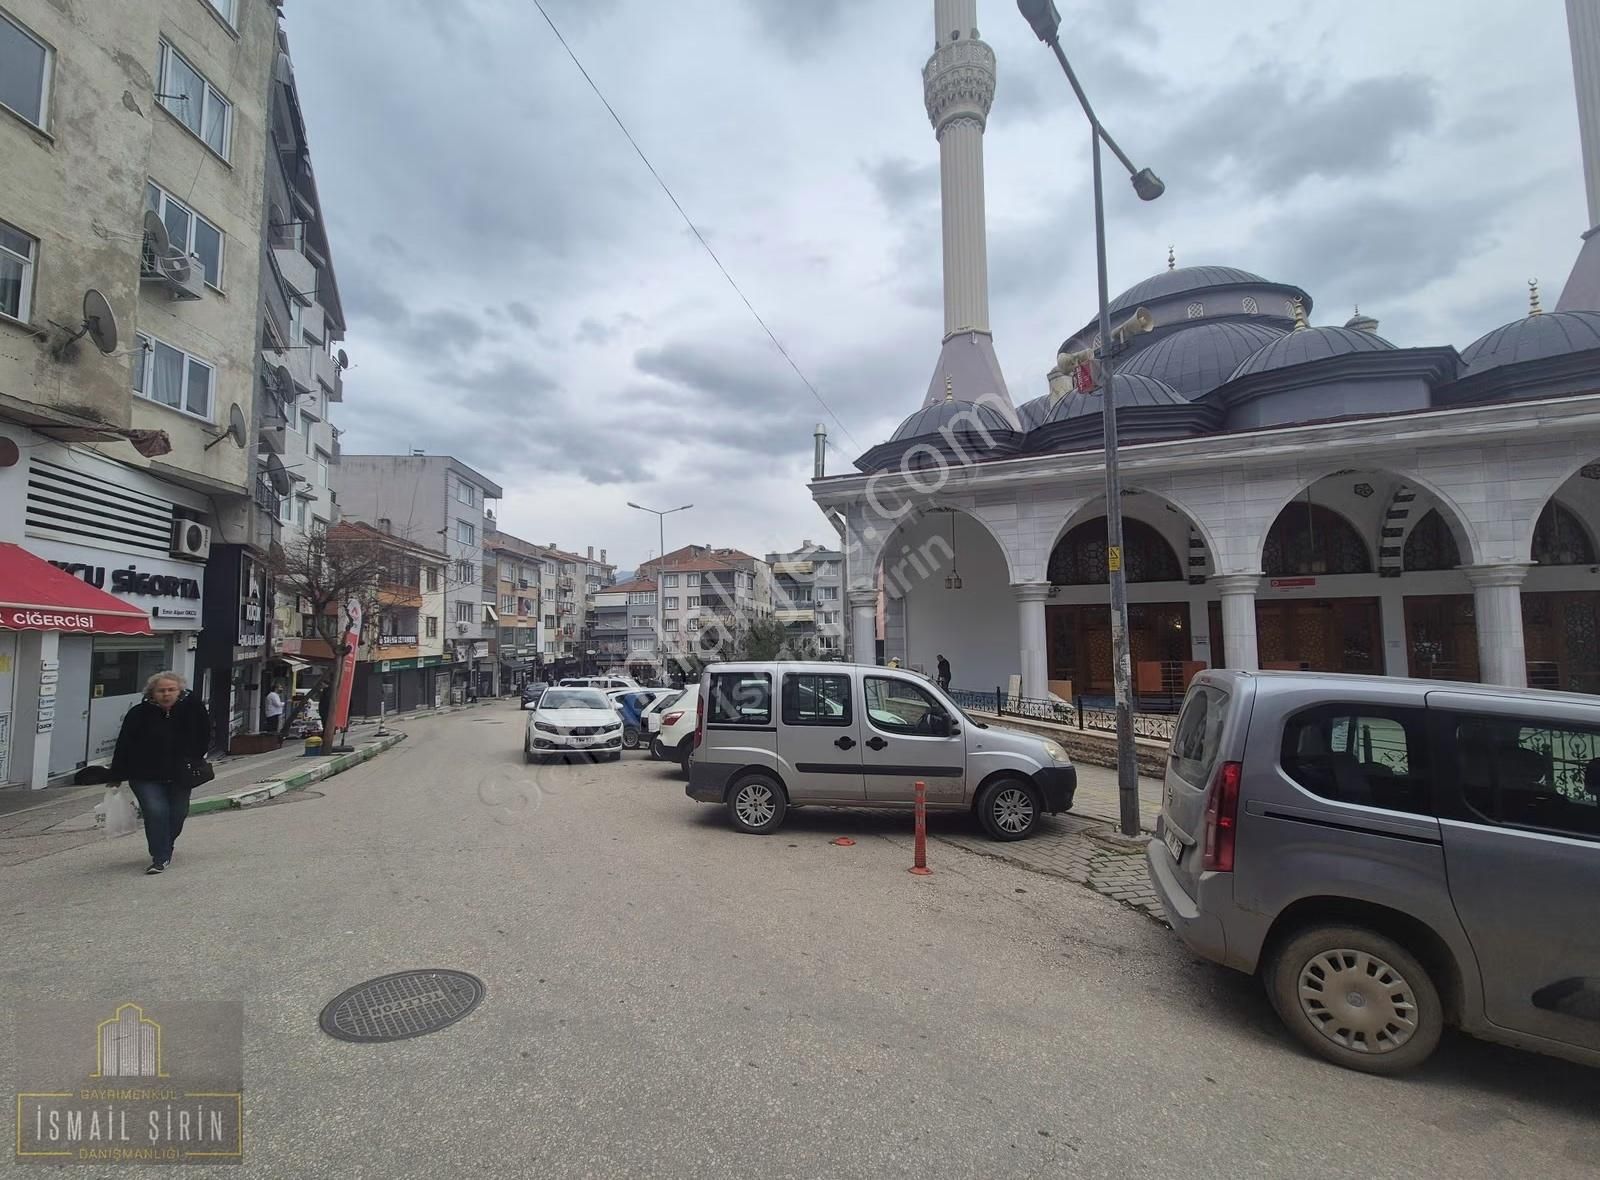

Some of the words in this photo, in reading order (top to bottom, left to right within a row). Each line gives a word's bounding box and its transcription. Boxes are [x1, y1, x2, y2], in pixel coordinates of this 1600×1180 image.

[111, 564, 201, 600] SİGORTA
[13, 611, 95, 629] CİĞERCİSİ
[371, 992, 443, 1017] TELEFON
